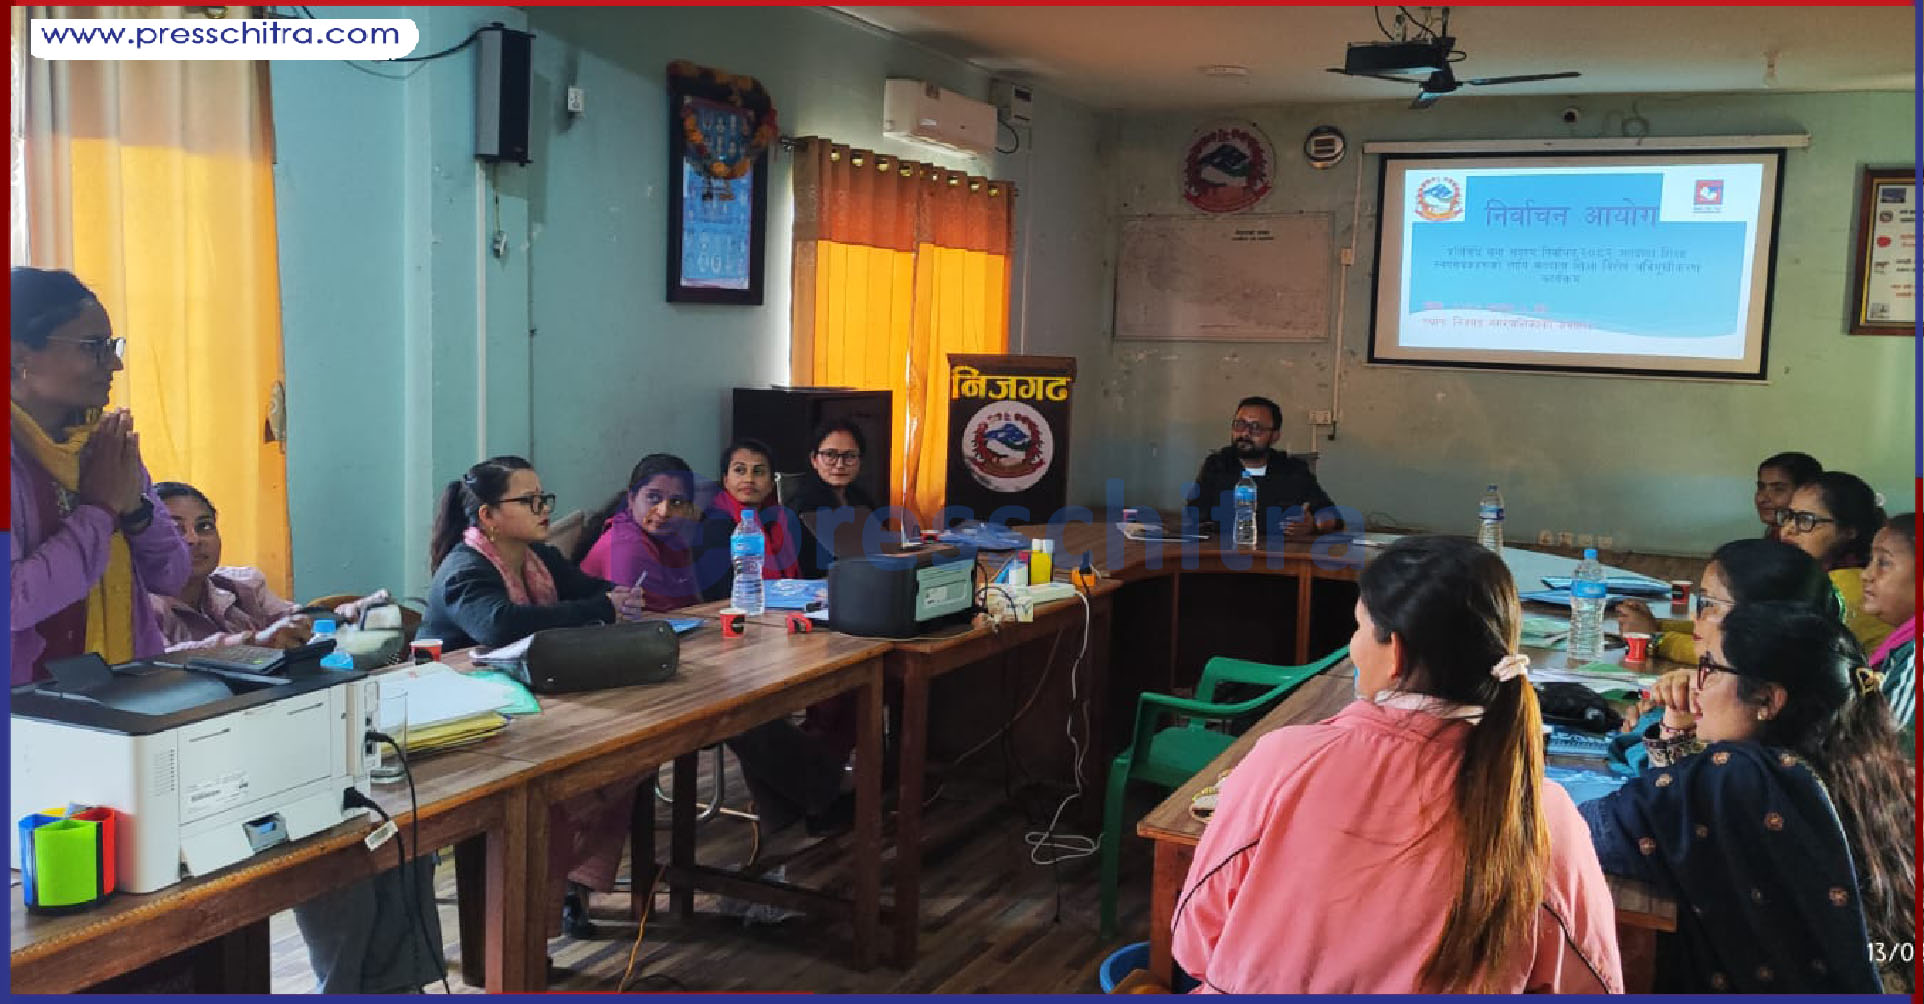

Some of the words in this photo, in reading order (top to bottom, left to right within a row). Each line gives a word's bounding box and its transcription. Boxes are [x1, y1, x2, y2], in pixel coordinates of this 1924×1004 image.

[1484, 198, 1571, 227] निर्वाचन
[1585, 197, 1661, 227] आयोग
[951, 365, 1072, 401] निजगढ
